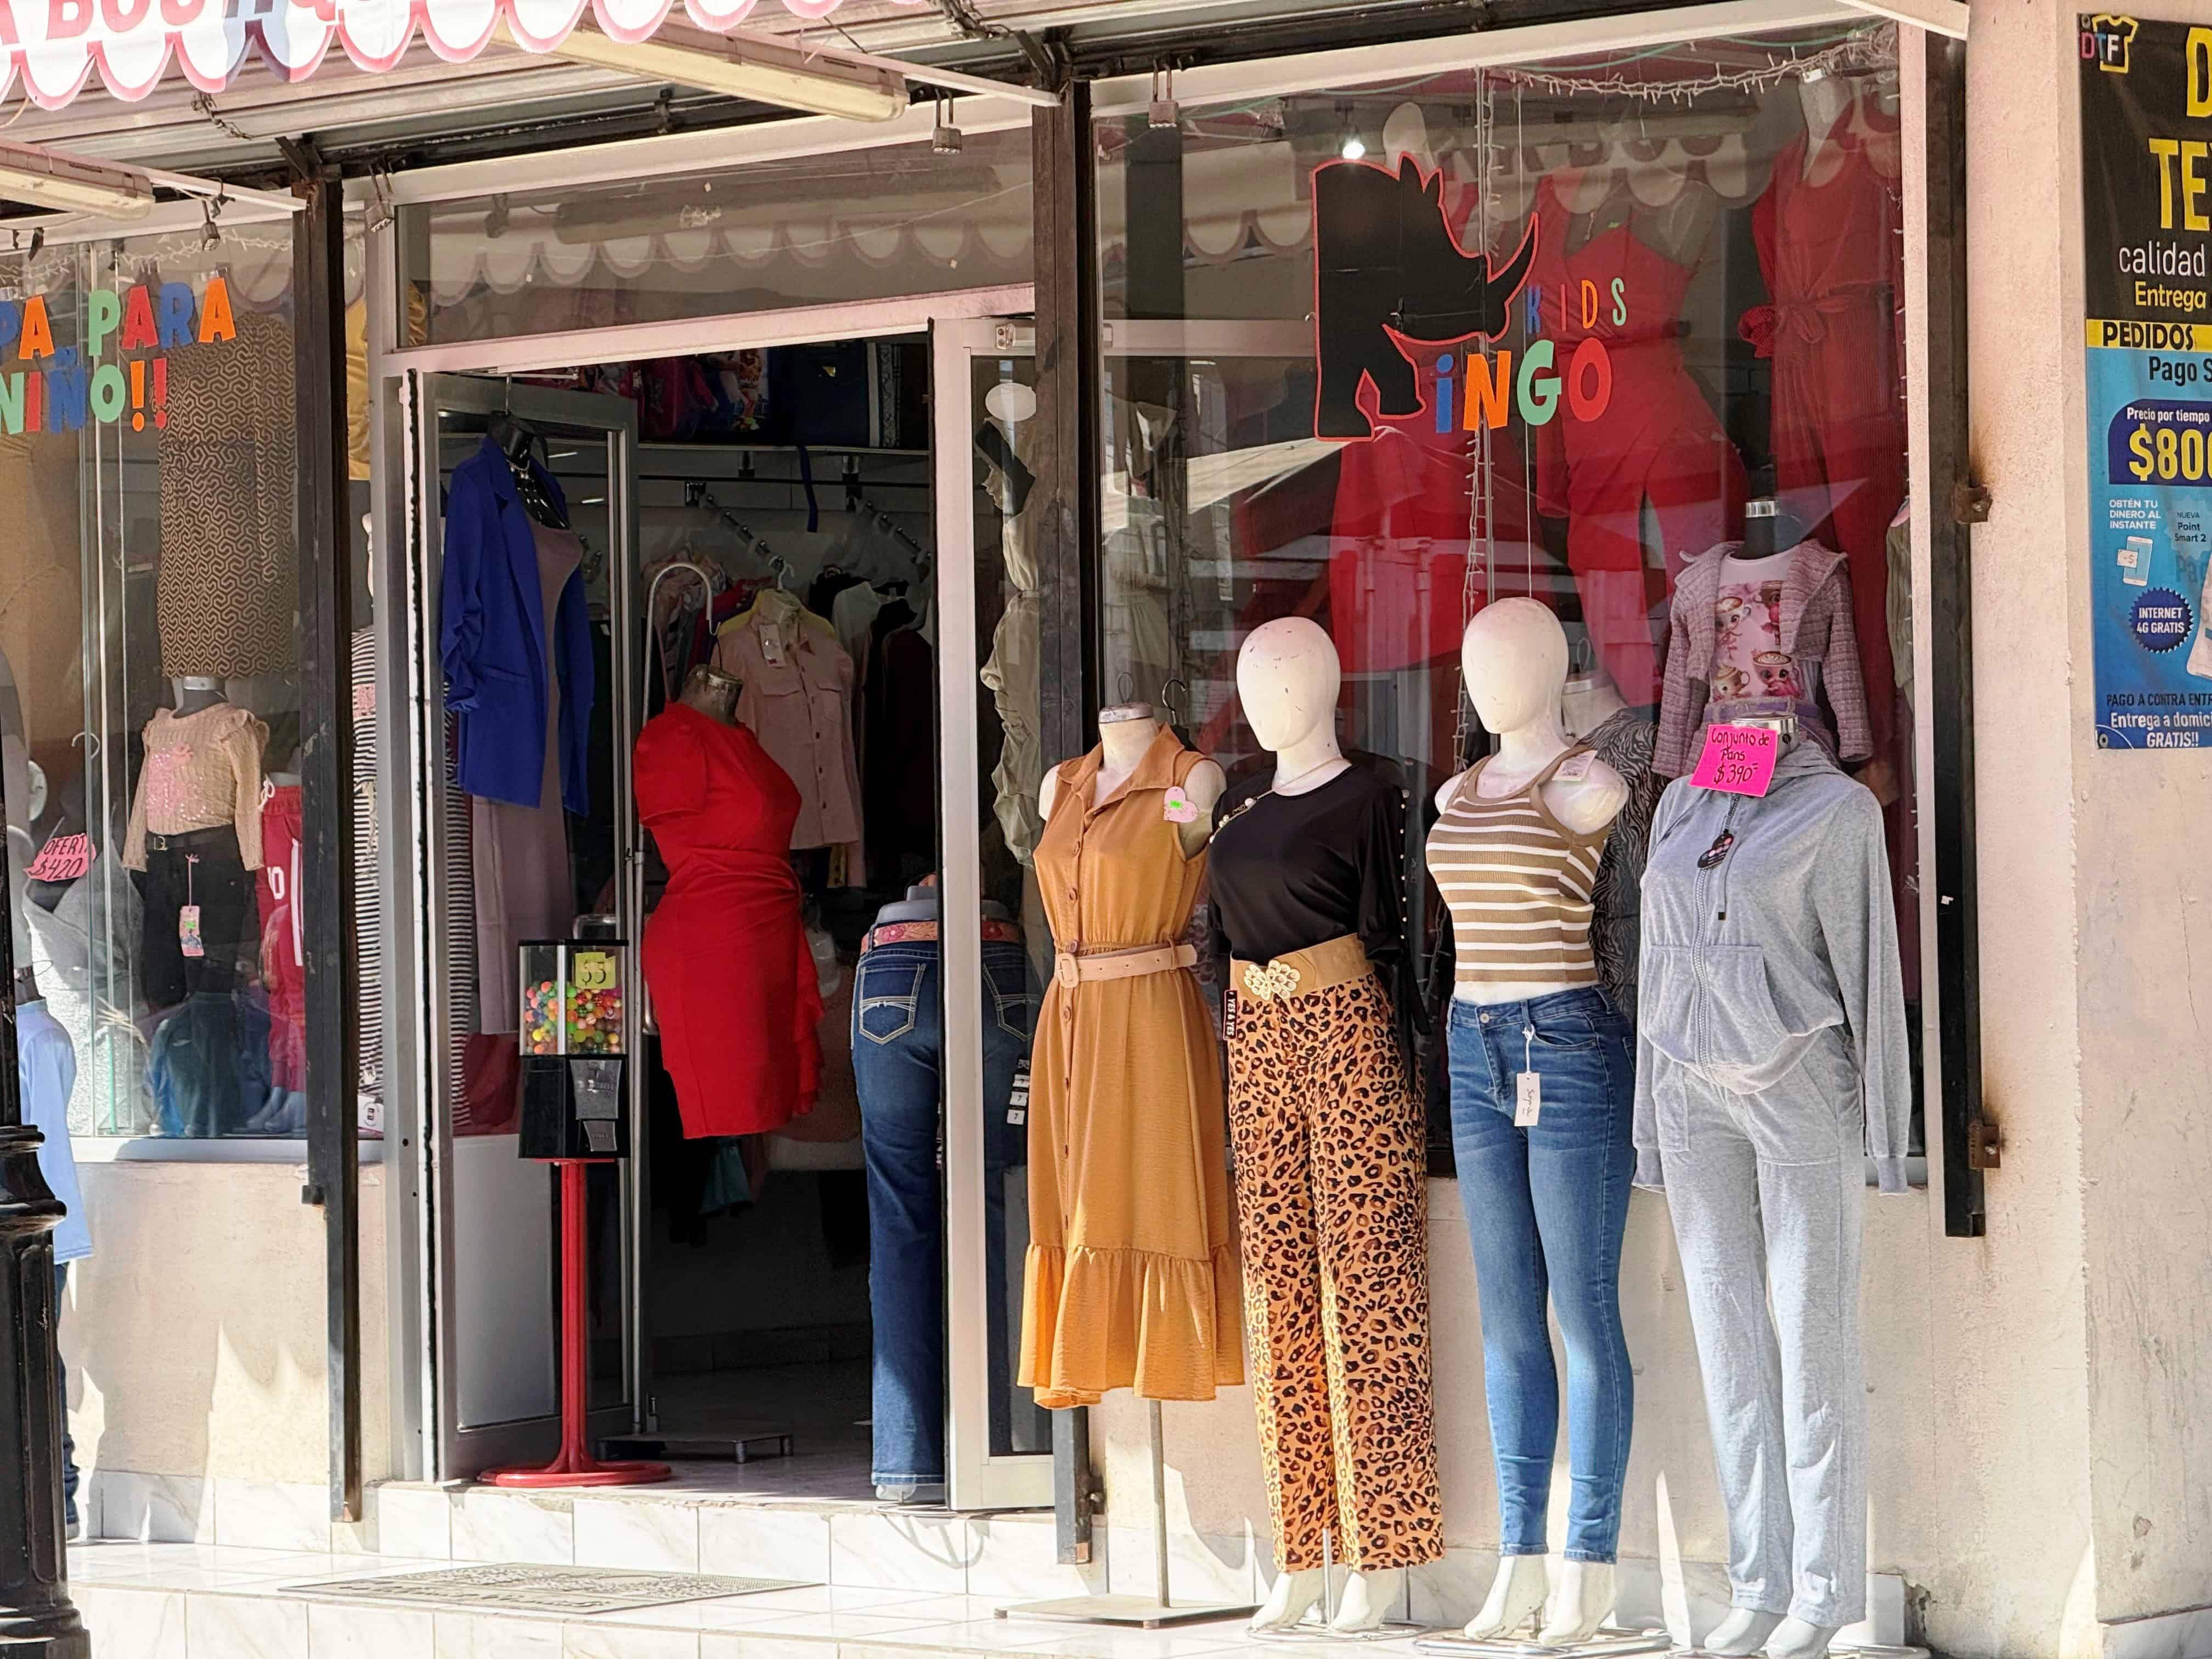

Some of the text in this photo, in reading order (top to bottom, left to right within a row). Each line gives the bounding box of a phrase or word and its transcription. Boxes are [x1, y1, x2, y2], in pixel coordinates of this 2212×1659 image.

[2080, 31, 2119, 62] DTF
[2149, 138, 2212, 231] TE
[2119, 240, 2205, 276] calidad
[2135, 281, 2207, 312] Entrega
[1527, 278, 1627, 334] KIDS
[88, 278, 236, 357] PARA
[2102, 321, 2194, 351] PEDIDOS
[2149, 356, 2197, 387] Pago
[2126, 407, 2210, 425] Precio por tiempo
[2129, 423, 2212, 482] $80
[2109, 498, 2158, 509] OBTÉN TU
[2109, 510, 2146, 518] DINERO
[2110, 521, 2156, 529] INSTANTE
[2177, 522, 2200, 531] Point
[2175, 533, 2207, 542] Smart 2
[2139, 607, 2183, 619] INTERNET
[2137, 622, 2185, 634] 4G GRATIS
[2107, 693, 2135, 706] PAGO
[2137, 693, 2146, 706] A
[2148, 693, 2185, 706] CONTRA
[2111, 712, 2160, 730] Entrega
[2163, 716, 2171, 727] a
[1712, 728, 1770, 748] Conjunto de
[2147, 731, 2199, 747] GRATIS!!
[1720, 748, 1745, 761] Pans
[28, 857, 83, 880] $420
[1227, 998, 1236, 1013] YES
[1226, 1021, 1235, 1036] YES
